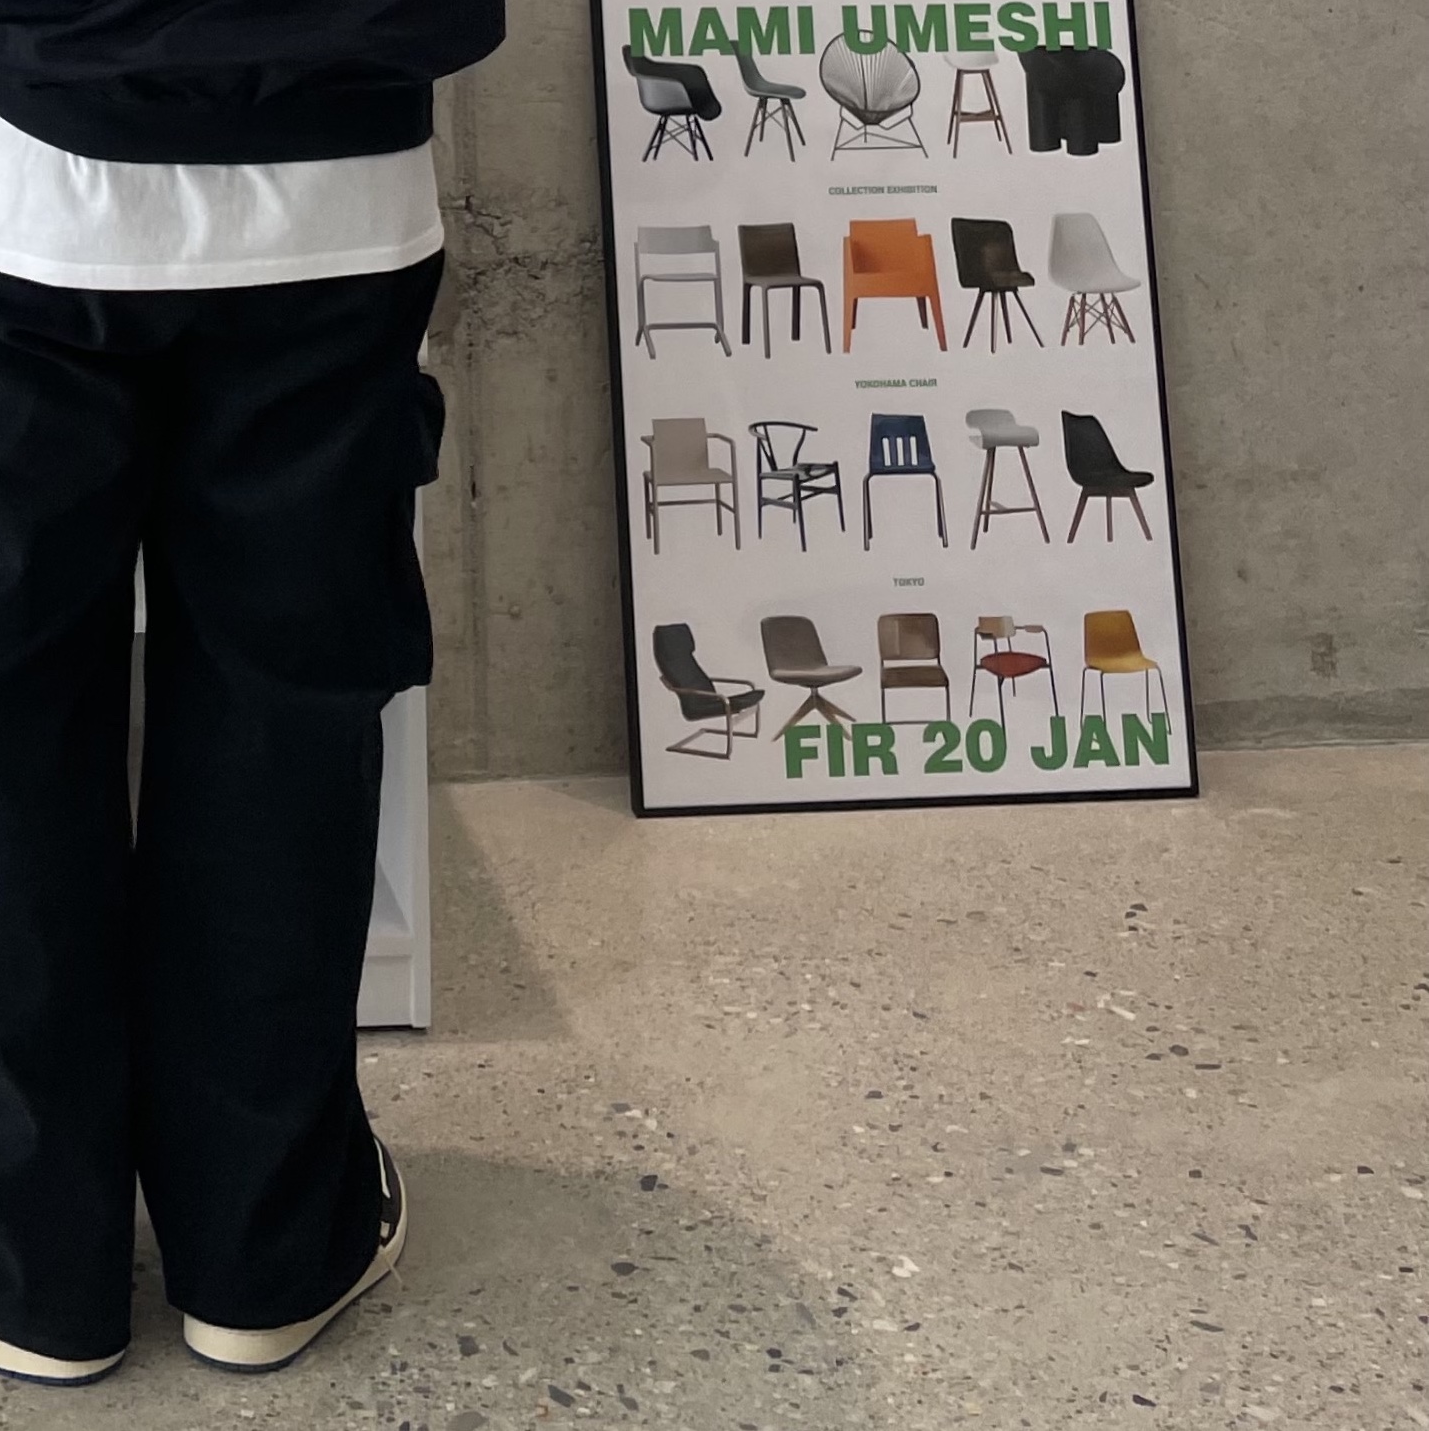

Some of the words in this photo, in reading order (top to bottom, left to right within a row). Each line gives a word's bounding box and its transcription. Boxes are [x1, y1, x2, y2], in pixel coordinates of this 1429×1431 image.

[628, 5, 814, 56] MAMI
[841, 1, 1114, 56] UMESHI
[828, 185, 885, 196] COLLECTION
[886, 184, 938, 195] EXHIBITION
[854, 378, 907, 389] YOKOHAMA
[908, 377, 938, 388] CHAIR
[892, 575, 925, 588] TOKYO
[784, 722, 899, 779] FIR
[923, 718, 1008, 775] 20
[1030, 712, 1170, 770] JAN
